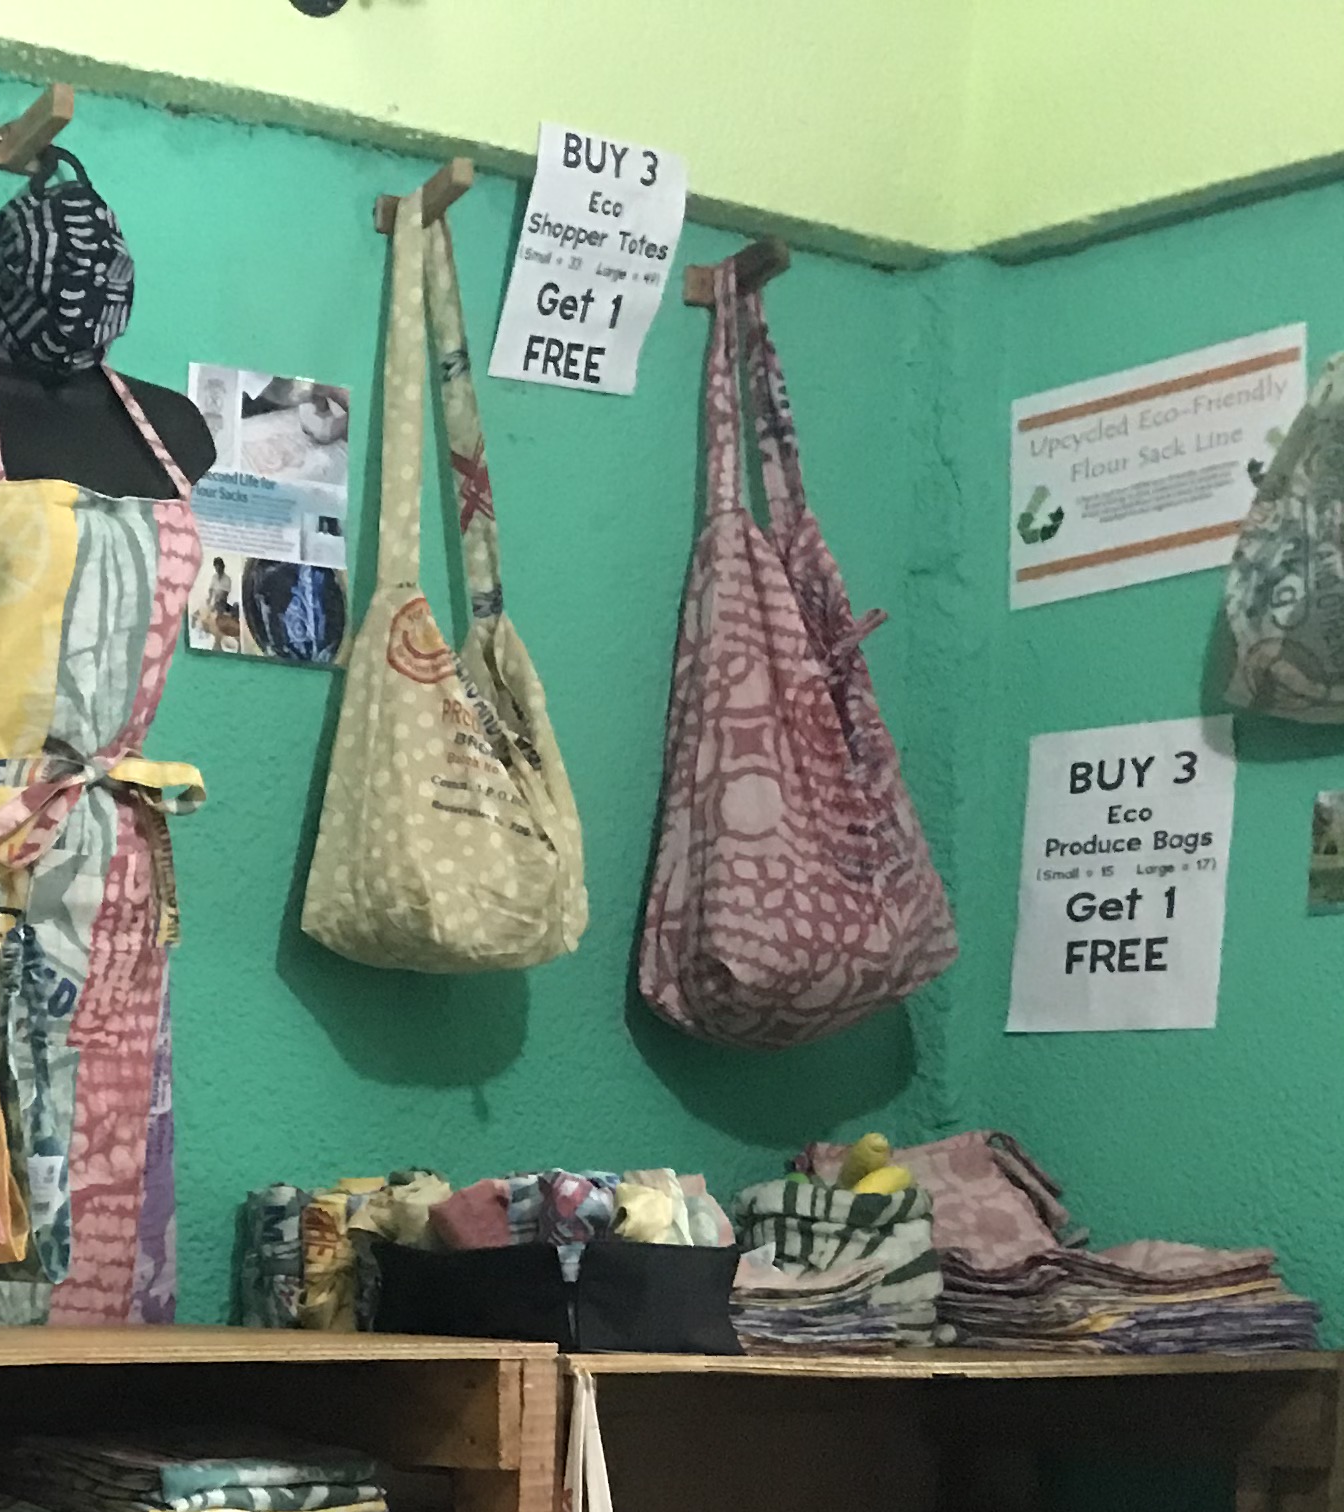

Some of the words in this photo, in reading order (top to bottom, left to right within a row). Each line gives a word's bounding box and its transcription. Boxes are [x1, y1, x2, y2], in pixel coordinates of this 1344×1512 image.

[563, 132, 629, 178] BUY
[640, 150, 658, 187] 3
[588, 191, 624, 218] Eco
[527, 212, 608, 250] Shopper
[619, 231, 669, 261] Totes
[537, 282, 594, 324] Get
[608, 294, 623, 330] 1
[522, 334, 606, 384] FREE
[1029, 411, 1130, 460] Upcycled
[1138, 373, 1288, 431] Eco-Friendly
[1069, 452, 1131, 483] Flour
[1138, 437, 1187, 465] Sack
[1195, 426, 1244, 454] Line
[1069, 756, 1155, 794] BUY
[1173, 751, 1198, 784] 3
[1107, 804, 1153, 824] Eco
[1045, 834, 1142, 858] Produce
[1153, 829, 1214, 854] Bags
[1136, 863, 1175, 877] Large
[1065, 887, 1143, 922] Get
[1164, 886, 1176, 919] 1
[1065, 936, 1169, 975] FREE
